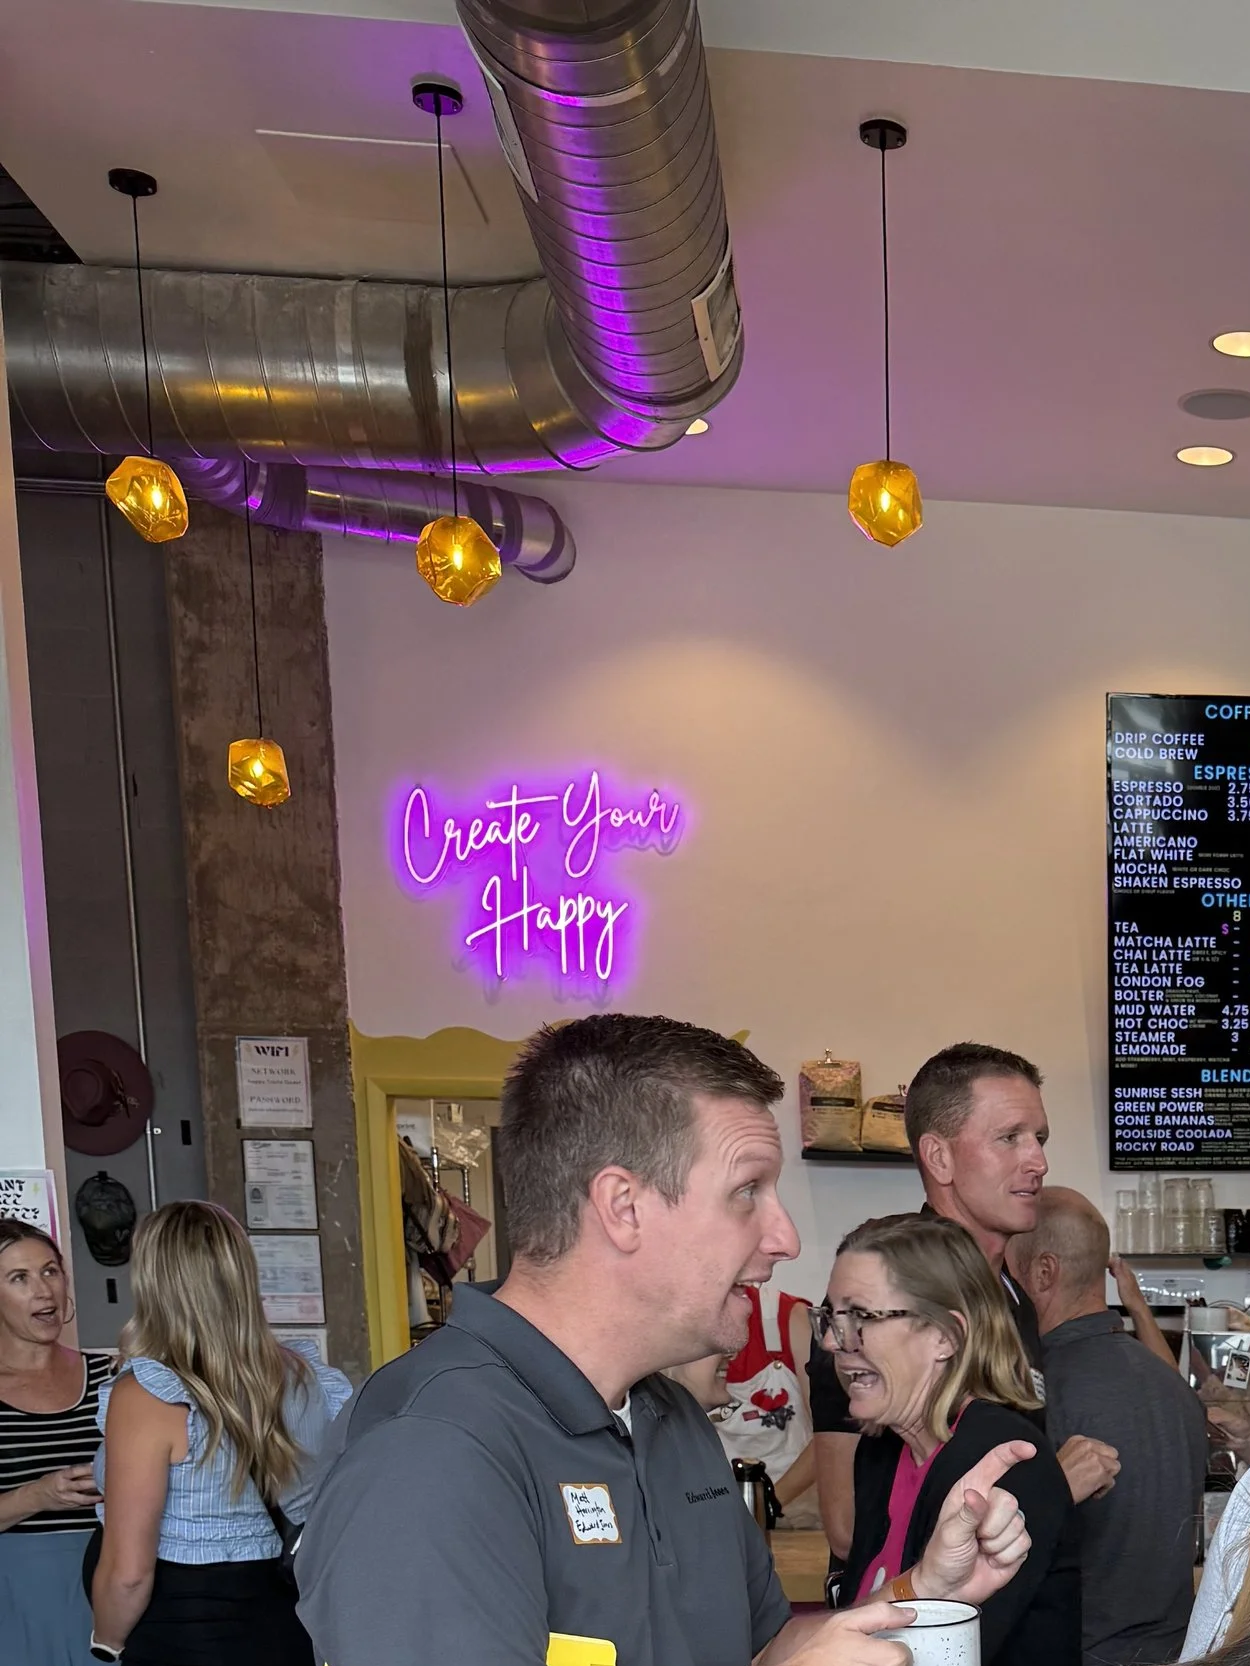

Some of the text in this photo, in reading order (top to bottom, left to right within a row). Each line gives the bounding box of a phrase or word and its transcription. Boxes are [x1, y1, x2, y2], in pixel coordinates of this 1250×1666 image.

[1115, 733, 1146, 744] DRIP
[1152, 734, 1204, 746] COFFEE
[1115, 748, 1197, 760] COLD BREW
[1113, 781, 1183, 793] ESPRESSO
[1113, 796, 1183, 807] CORTADO
[1113, 809, 1208, 821] CAPPUCCINO
[404, 770, 680, 884] Create Your
[1114, 823, 1153, 833] LATTE
[1114, 837, 1197, 848] AMERICANO
[1114, 850, 1145, 860] FLAT
[1151, 850, 1193, 861] WHITE
[1115, 864, 1167, 874] MOCHA
[1114, 877, 1168, 888] SHAKEN
[1173, 878, 1241, 889] ESPRESSO
[465, 866, 629, 980] Happy
[1115, 922, 1138, 933] TEA
[1114, 937, 1172, 947] MATCHA
[1178, 937, 1216, 948] LATTE
[1113, 950, 1147, 961] CHAI
[1153, 950, 1191, 961] LATTE
[1115, 963, 1139, 974] TEA
[1144, 963, 1182, 974] LATTE
[1115, 977, 1171, 987] LONDON
[1177, 977, 1205, 987] FOG
[1114, 991, 1164, 1001] BOLTER
[1115, 1005, 1145, 1015] MUD
[1150, 1005, 1195, 1016] WATER
[1222, 1005, 1249, 1015] 4.75
[1115, 1018, 1142, 1029] HOT
[1148, 1018, 1188, 1029] CHOC
[1222, 1019, 1248, 1029] 3.25
[1115, 1032, 1175, 1042] STEAMER
[1115, 1045, 1186, 1055] LEMONADE
[1115, 1088, 1166, 1098] SUNRISE
[1171, 1088, 1202, 1098] SESH
[1115, 1102, 1155, 1112] GREEN
[1159, 1102, 1204, 1112] POWER
[1115, 1115, 1151, 1126] GONE
[1155, 1115, 1214, 1126] BANANAS
[1115, 1129, 1171, 1139] POOLSIDE
[1175, 1128, 1232, 1139] COOLADA
[1115, 1142, 1156, 1152] ROCKY
[1161, 1142, 1194, 1152] ROAD
